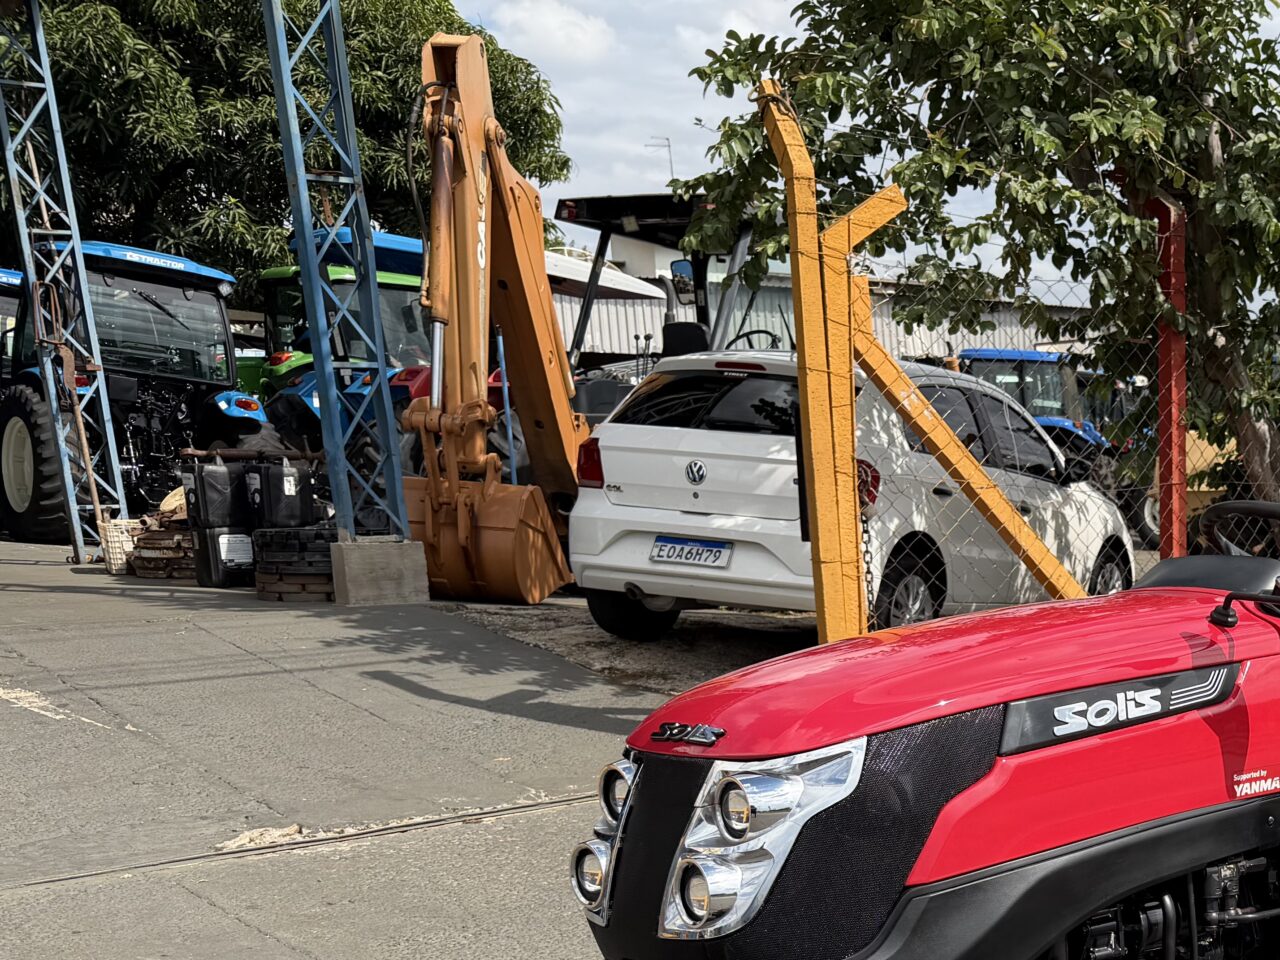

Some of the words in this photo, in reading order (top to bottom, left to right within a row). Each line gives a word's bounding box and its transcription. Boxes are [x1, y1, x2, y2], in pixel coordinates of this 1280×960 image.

[141, 255, 185, 270] TRACTOR
[657, 544, 722, 563] EOA6H79
[1233, 770, 1260, 781] Supported
[1261, 769, 1267, 777] by
